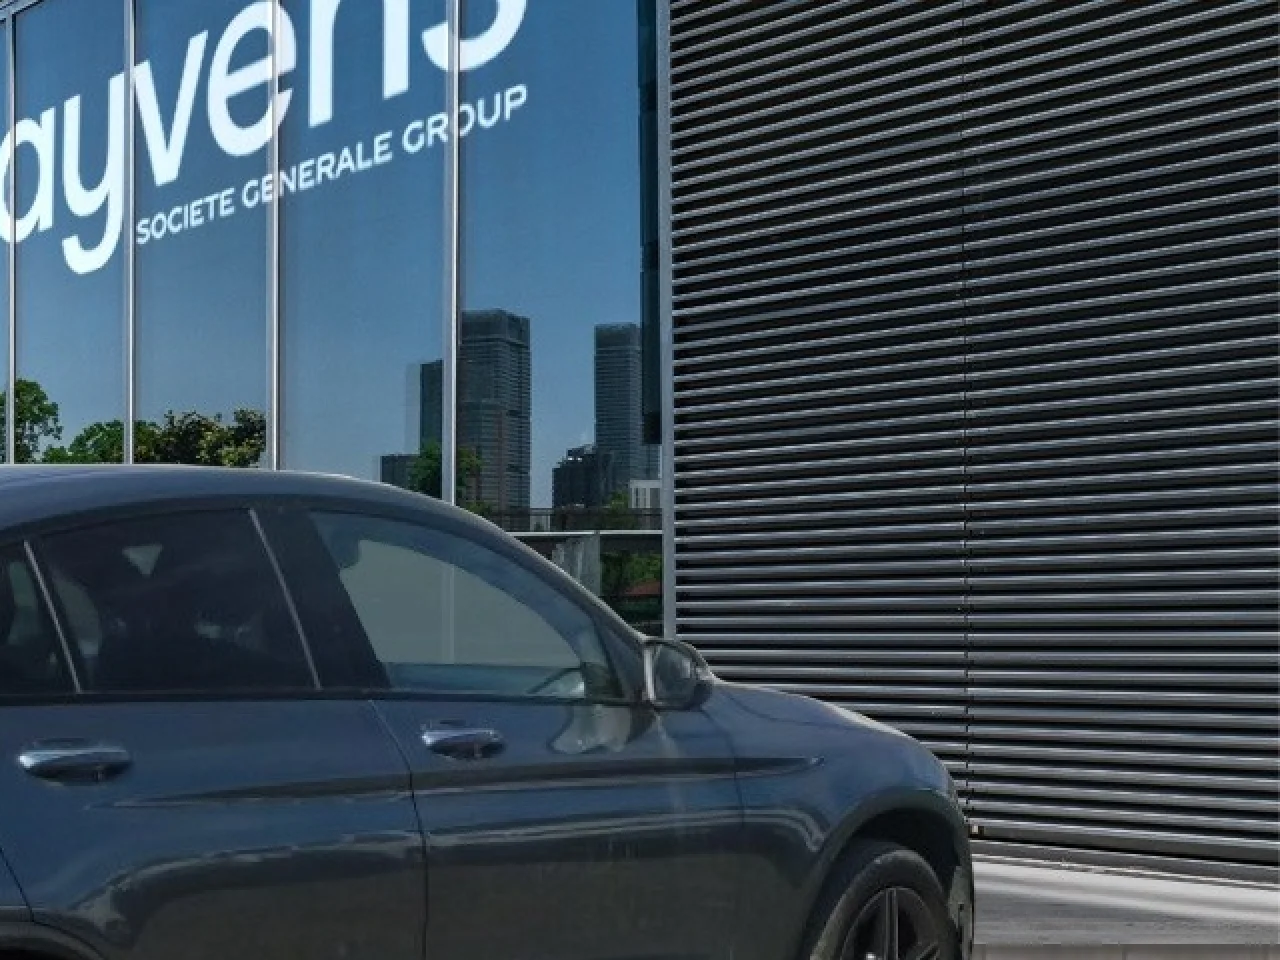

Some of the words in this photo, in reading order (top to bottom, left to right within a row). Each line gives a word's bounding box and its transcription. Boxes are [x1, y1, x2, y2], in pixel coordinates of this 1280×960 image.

[135, 187, 236, 245] SOCIETE
[241, 130, 393, 207] GENERALE
[402, 83, 527, 154] GROUP
